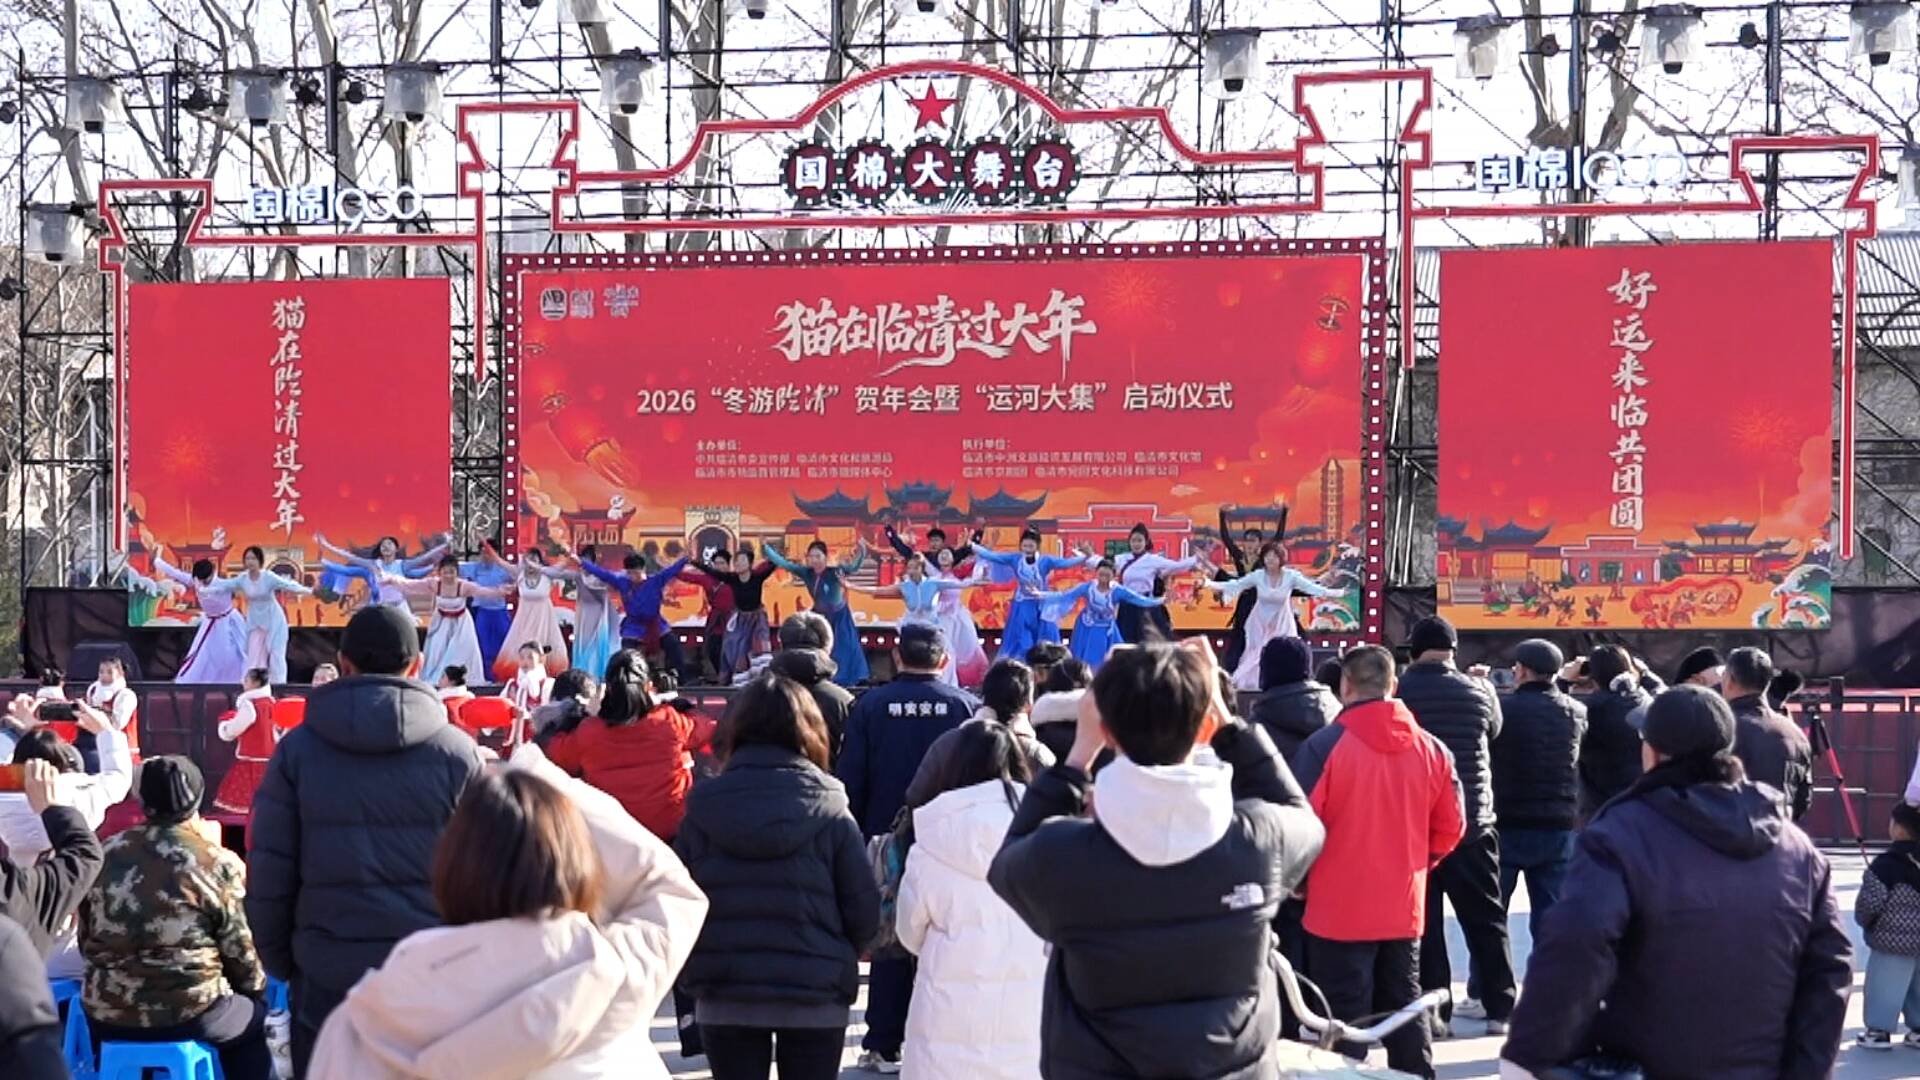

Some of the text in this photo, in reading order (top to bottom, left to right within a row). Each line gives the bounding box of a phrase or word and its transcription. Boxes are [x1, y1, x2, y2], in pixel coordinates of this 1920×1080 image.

[794, 149, 1064, 191] 国棉大舞台
[774, 289, 1097, 379] 猫在临清过大年
[269, 296, 306, 536] 猫在临清过大年
[638, 389, 695, 412] 2026
[855, 384, 960, 412] 贺年会暨
[976, 382, 1106, 411] “运河大集”
[1123, 381, 1233, 410] 启动仪式
[1607, 268, 1657, 531] 好运来临共团圆
